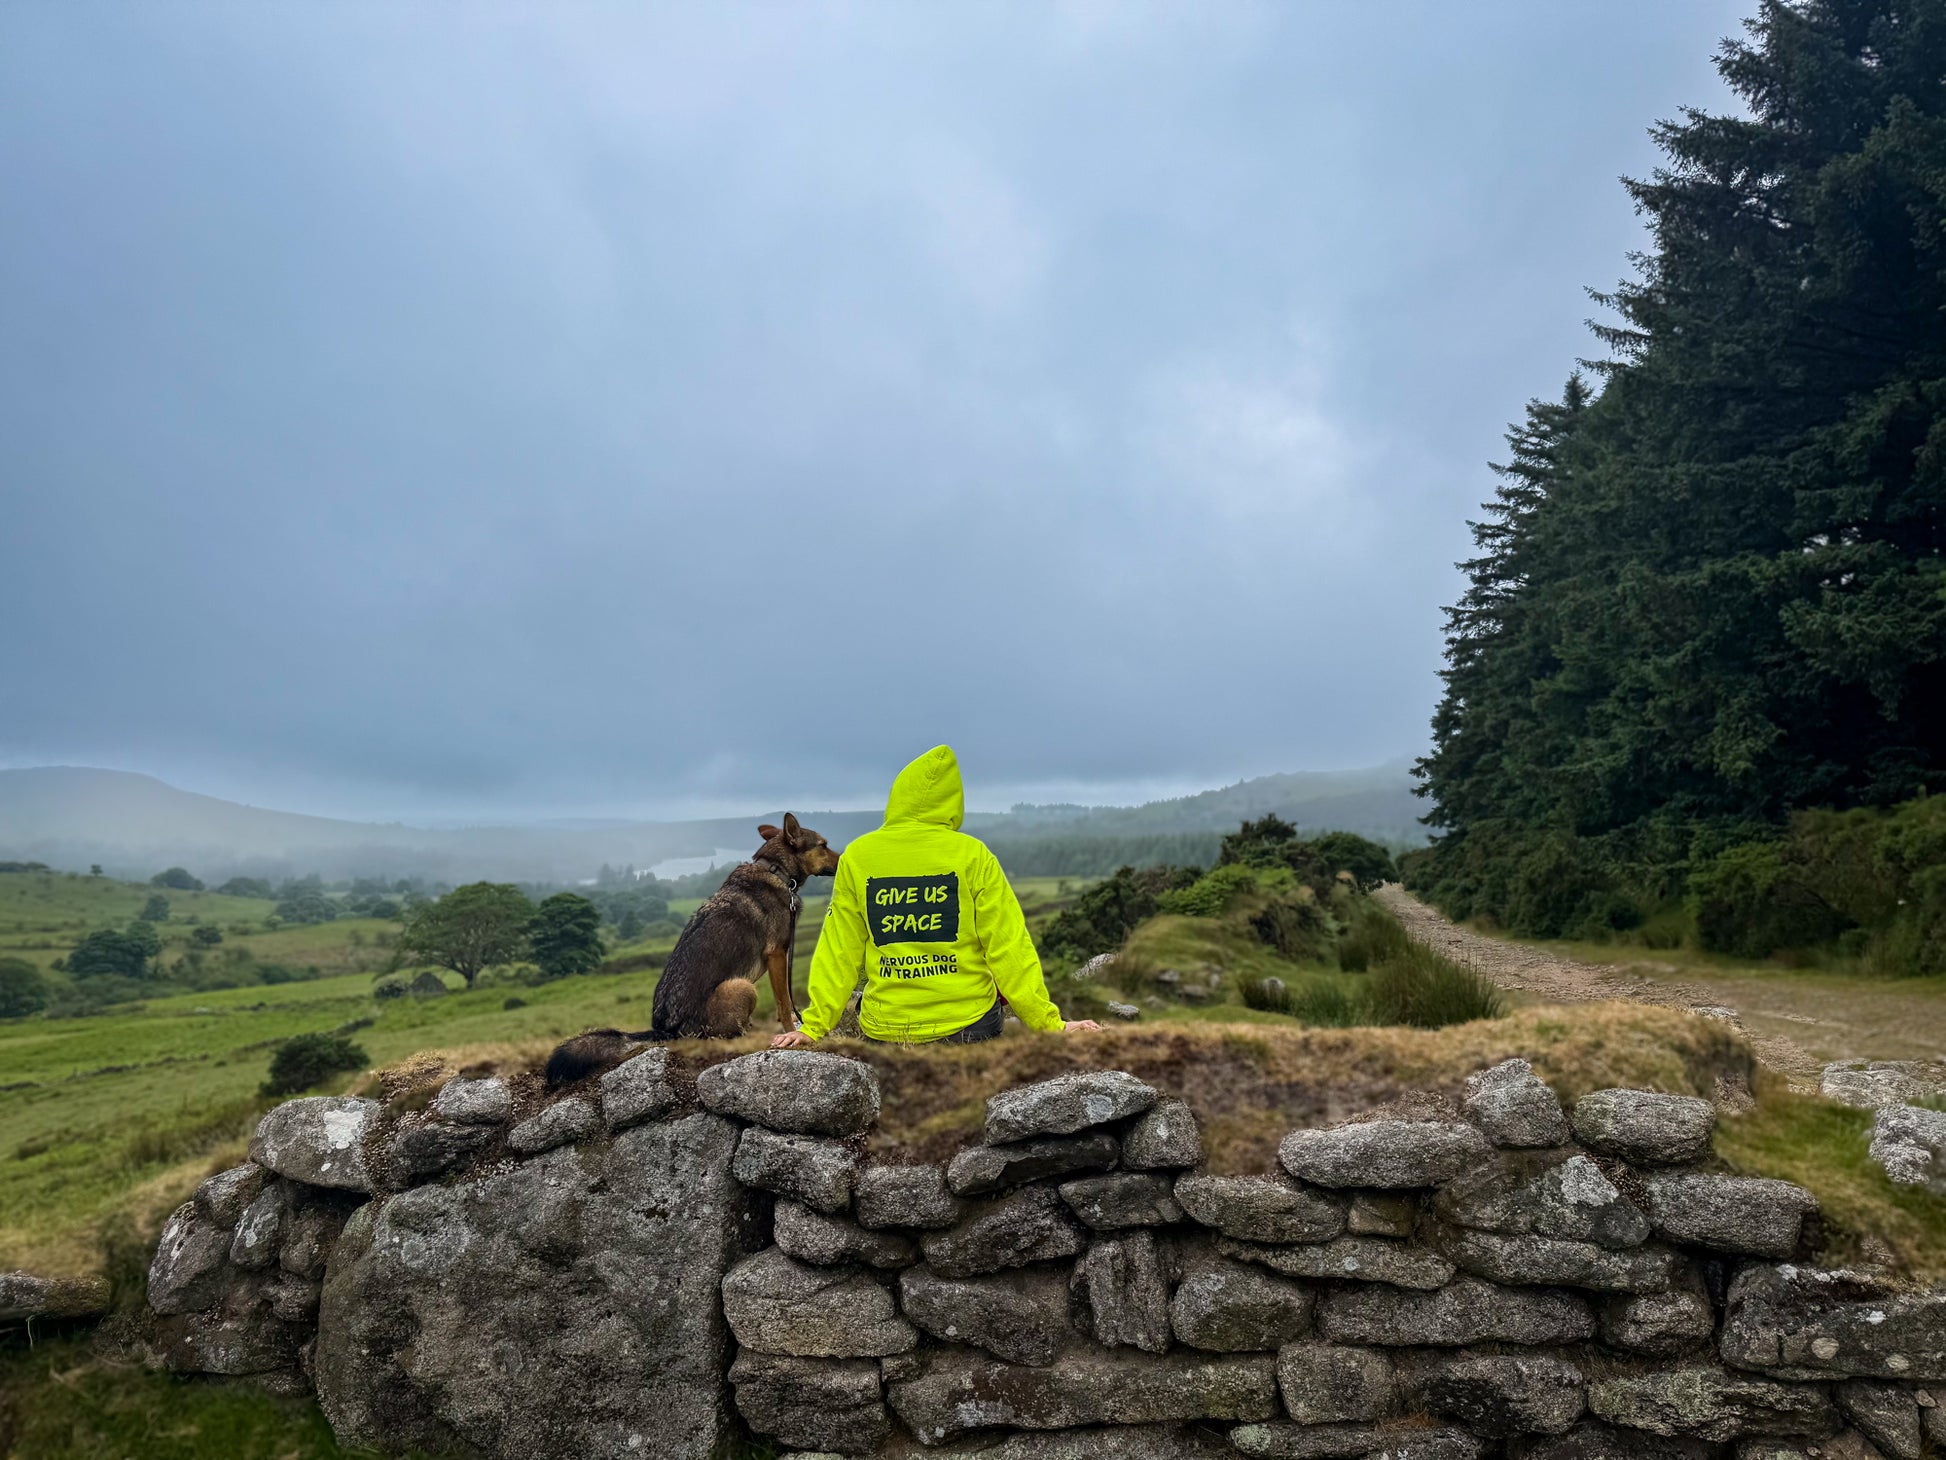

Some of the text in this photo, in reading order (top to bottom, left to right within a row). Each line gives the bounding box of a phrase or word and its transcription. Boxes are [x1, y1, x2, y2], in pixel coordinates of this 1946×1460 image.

[875, 885, 948, 906] GIVE US
[881, 913, 942, 933] SPACE
[879, 954, 957, 966] NERVOUS DOG
[879, 964, 957, 979] IN TRAINING
